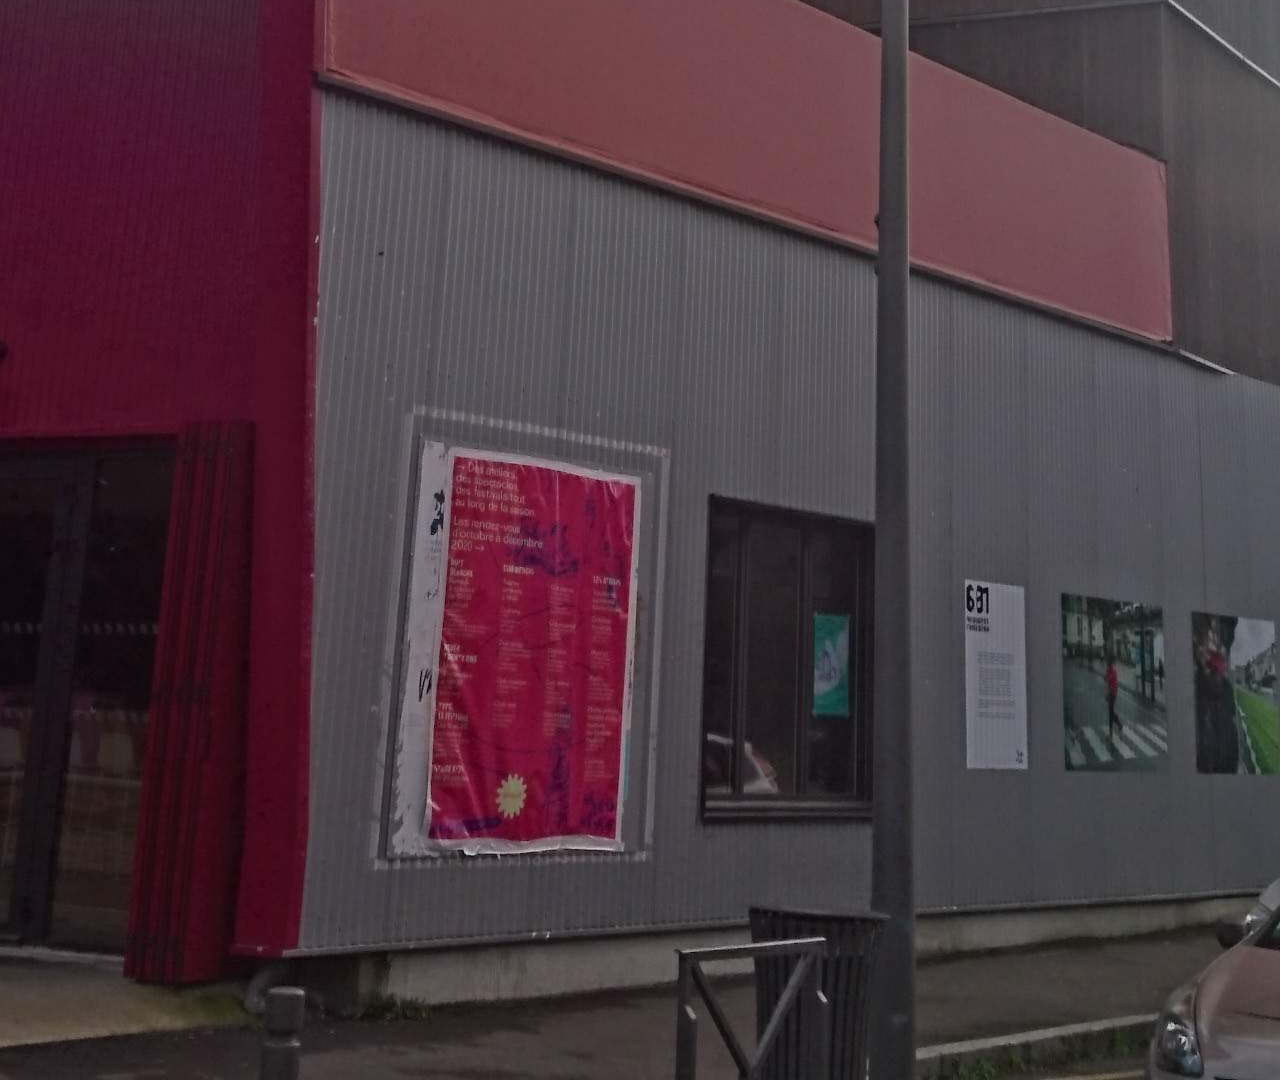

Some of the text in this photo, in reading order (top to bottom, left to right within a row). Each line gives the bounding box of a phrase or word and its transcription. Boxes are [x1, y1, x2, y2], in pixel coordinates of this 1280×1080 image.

[467, 497, 485, 512] long
[488, 500, 498, 511] de
[454, 515, 470, 527] Les
